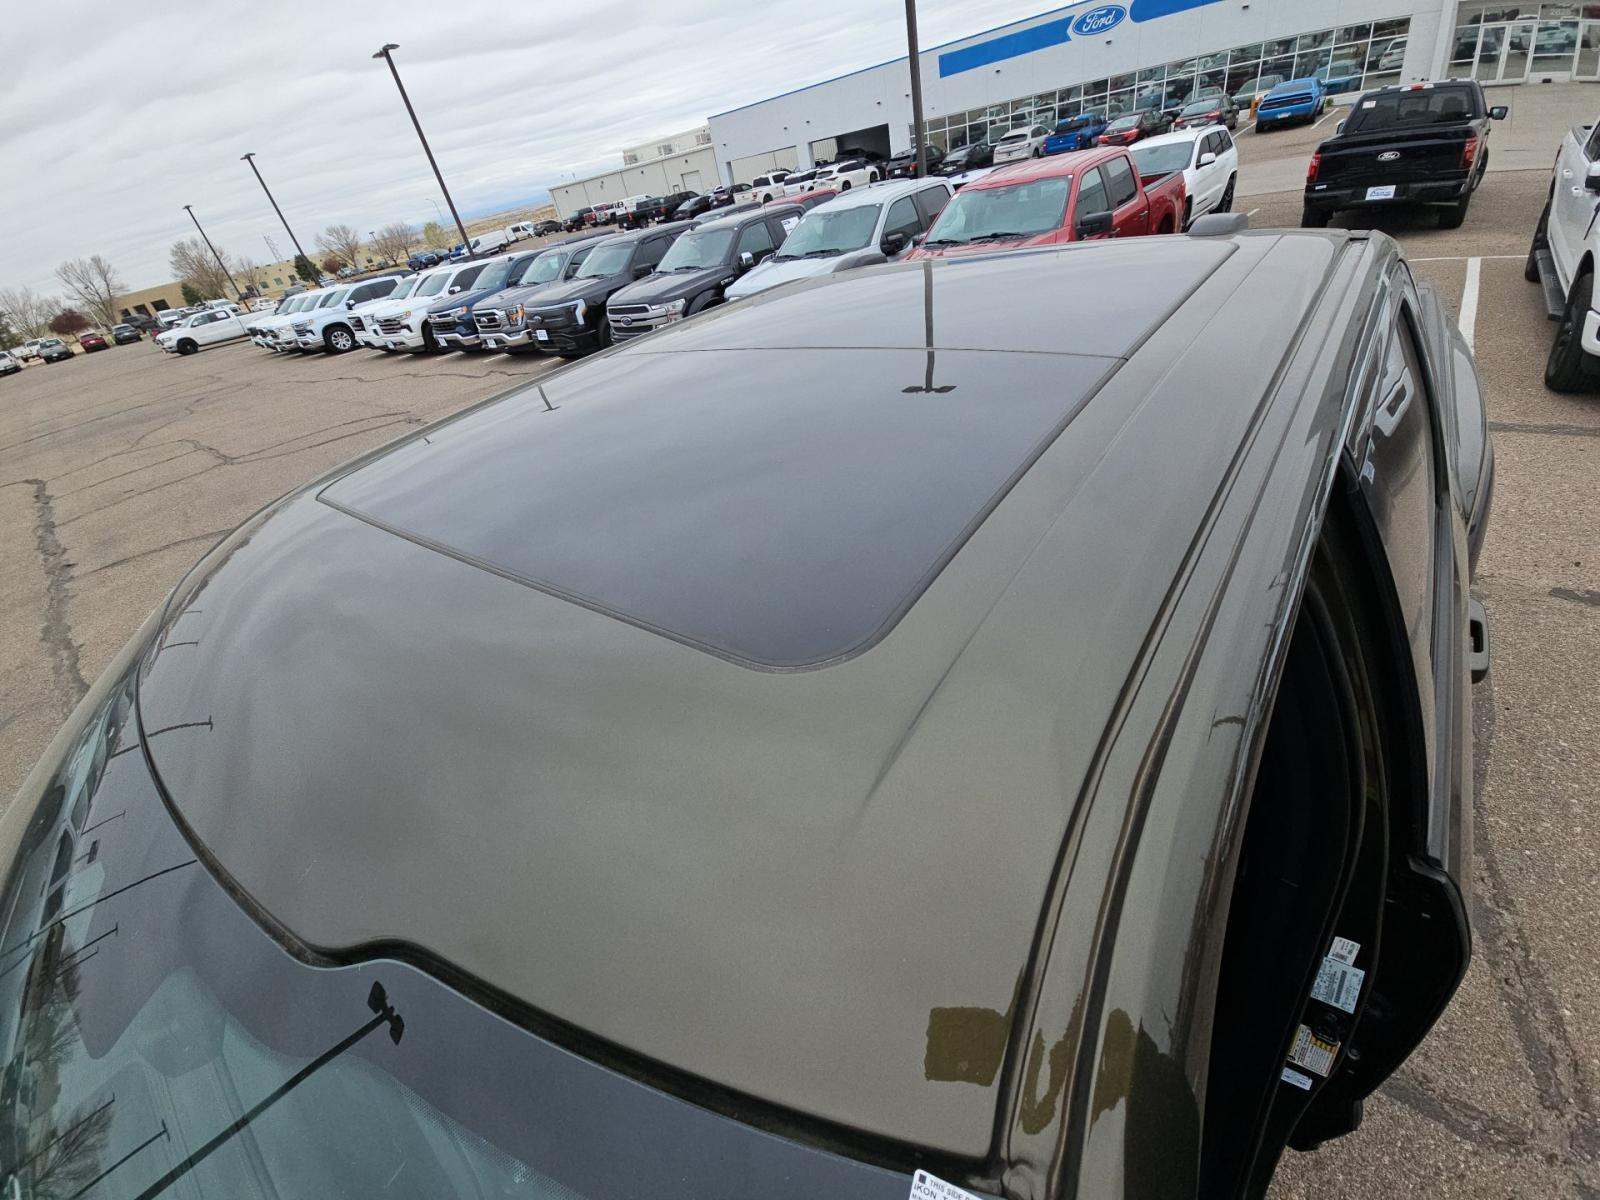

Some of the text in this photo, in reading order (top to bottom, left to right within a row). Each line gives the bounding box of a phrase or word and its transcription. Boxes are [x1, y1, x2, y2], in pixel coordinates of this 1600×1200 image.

[1081, 9, 1117, 32] Ford
[914, 1183, 937, 1199] IKON
[930, 1180, 945, 1192] THIS
